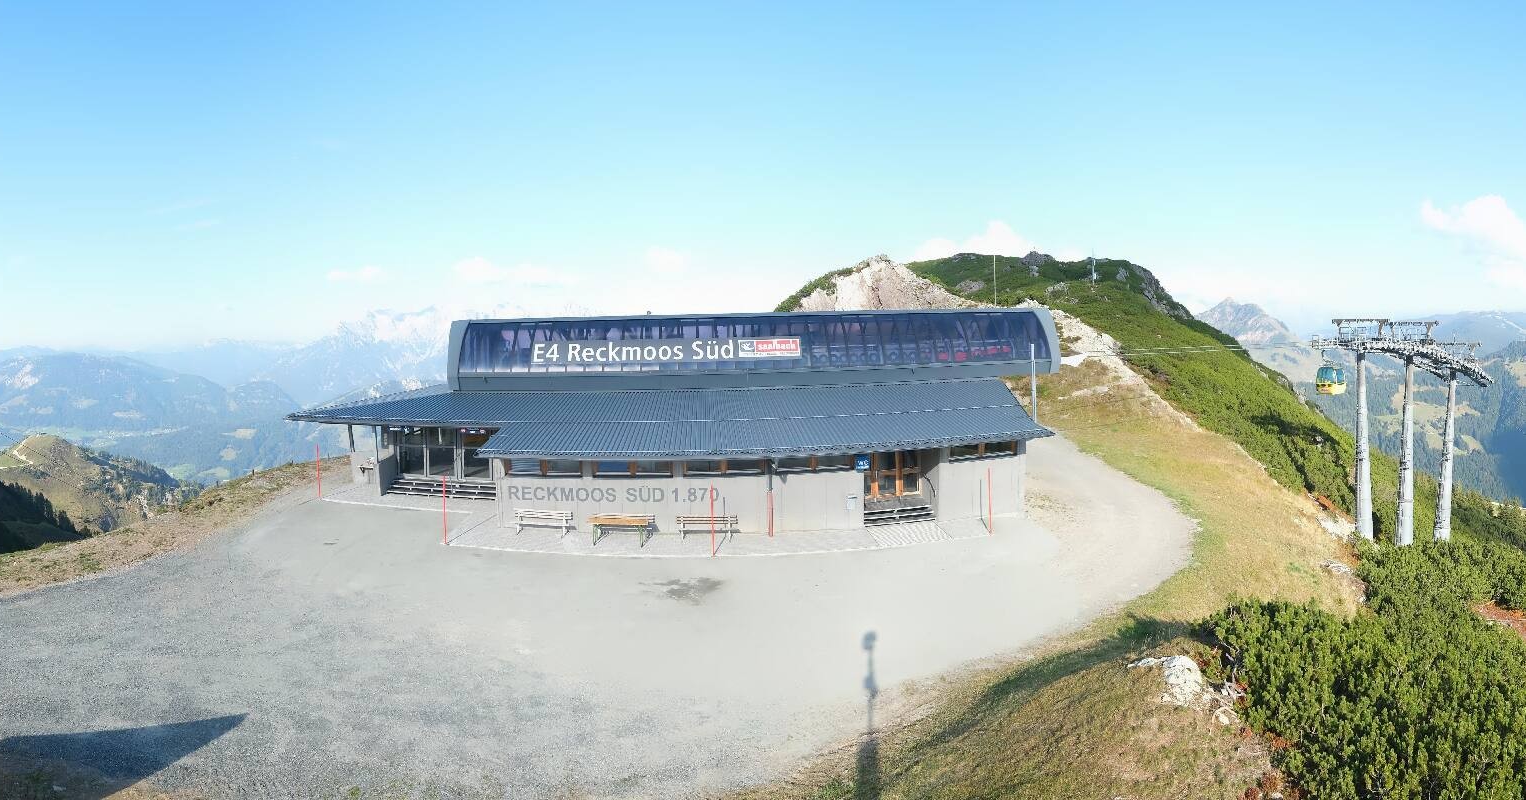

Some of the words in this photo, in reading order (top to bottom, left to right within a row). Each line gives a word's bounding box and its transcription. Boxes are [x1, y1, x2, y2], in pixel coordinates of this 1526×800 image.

[533, 343, 560, 362] E4
[567, 341, 684, 361] Reckmoos
[691, 340, 734, 360] Süd
[507, 485, 617, 502] RECKMOOS
[626, 485, 665, 503] SÜD
